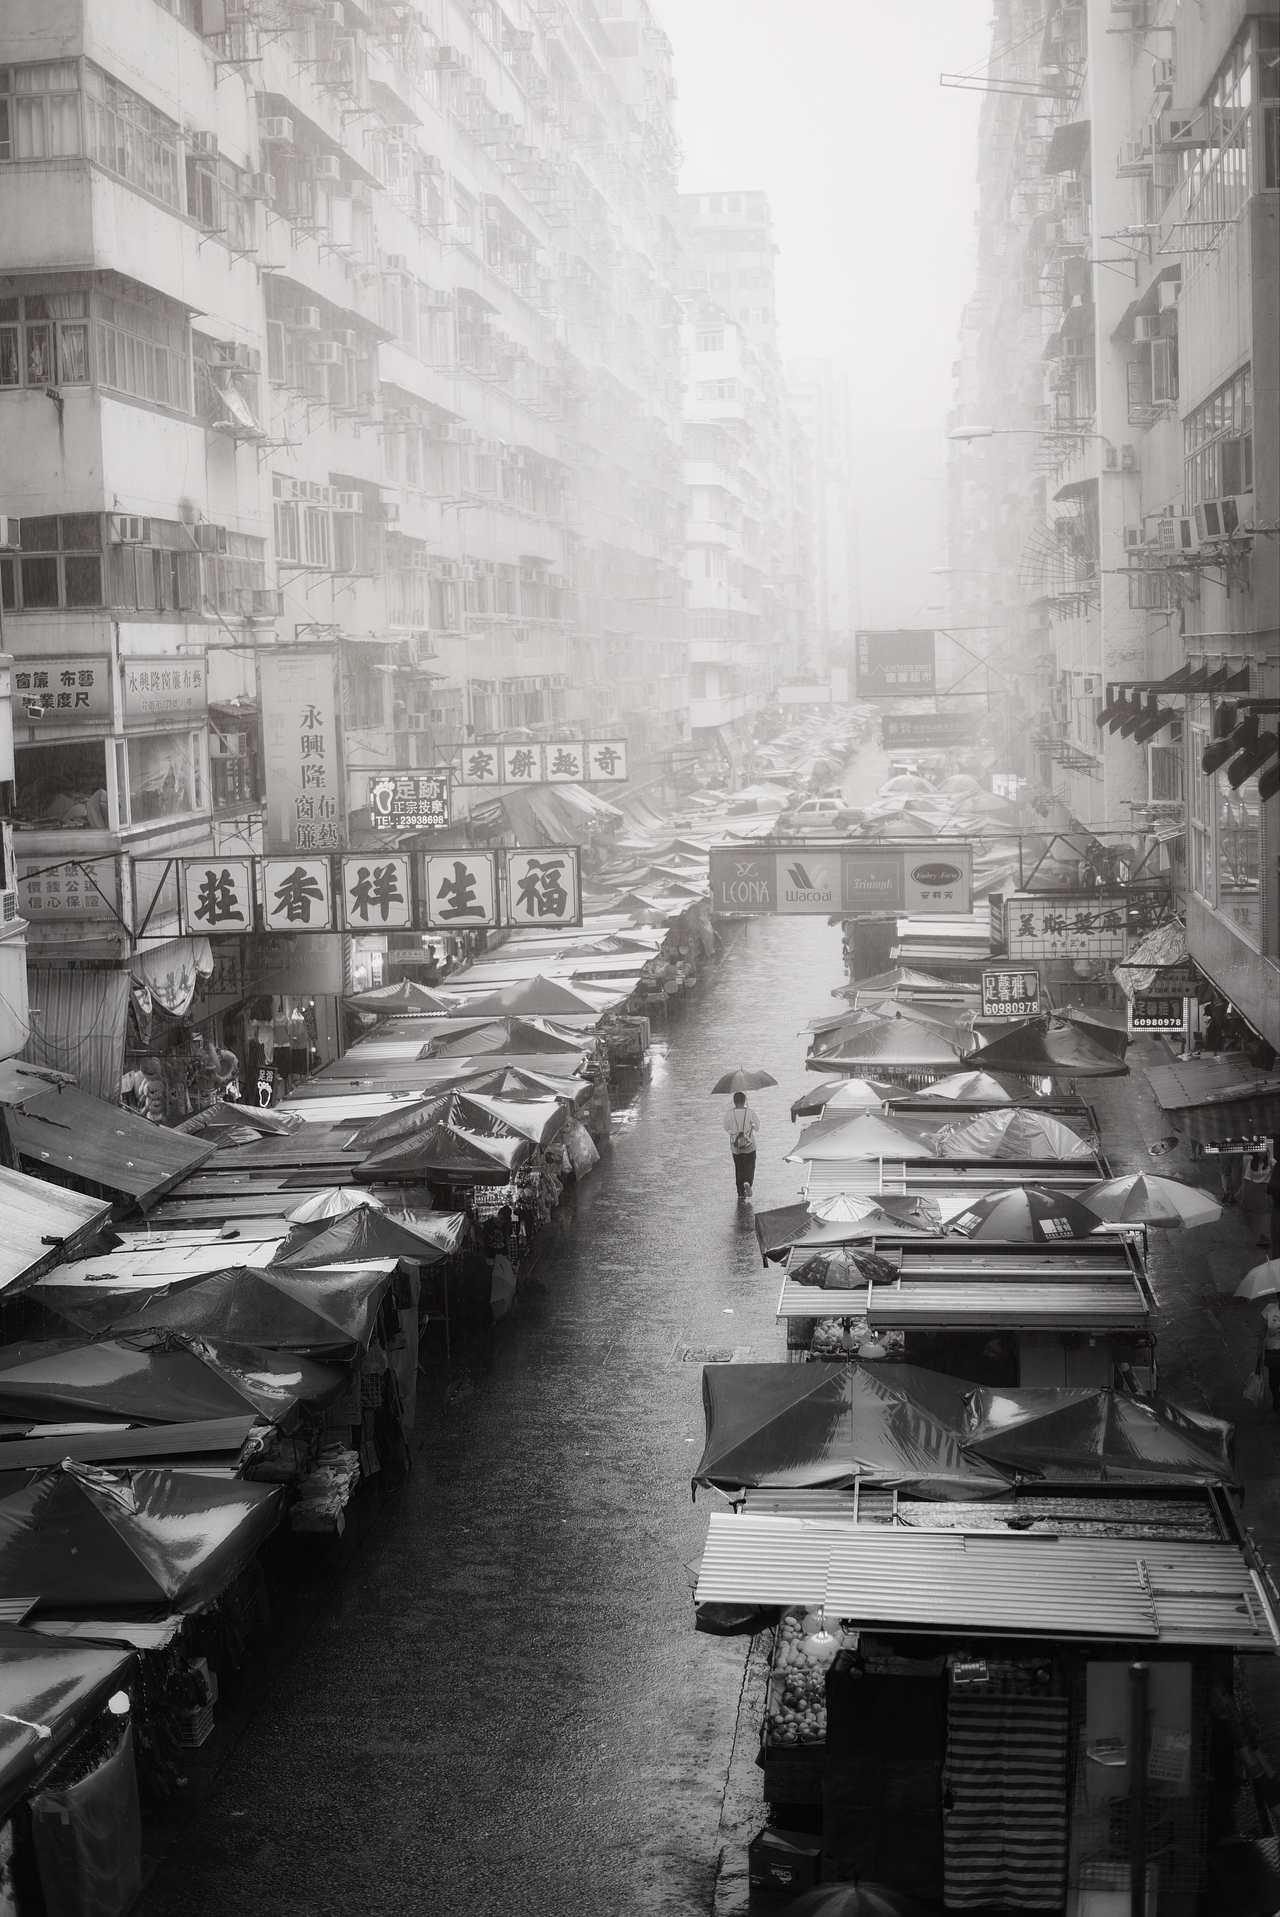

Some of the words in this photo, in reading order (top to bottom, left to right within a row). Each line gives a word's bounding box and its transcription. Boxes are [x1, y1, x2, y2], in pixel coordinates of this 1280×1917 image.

[15, 671, 49, 689] 窗簾
[60, 670, 95, 687] 布藝
[392, 800, 444, 814] 正宗按摩
[853, 878, 892, 891] Triumph
[786, 891, 831, 902] Wacoal
[920, 891, 953, 899] 安莉芳
[28, 895, 100, 909] 信心保證
[985, 1002, 1038, 1014] 60980978
[1134, 1018, 1181, 1026] 60980978
